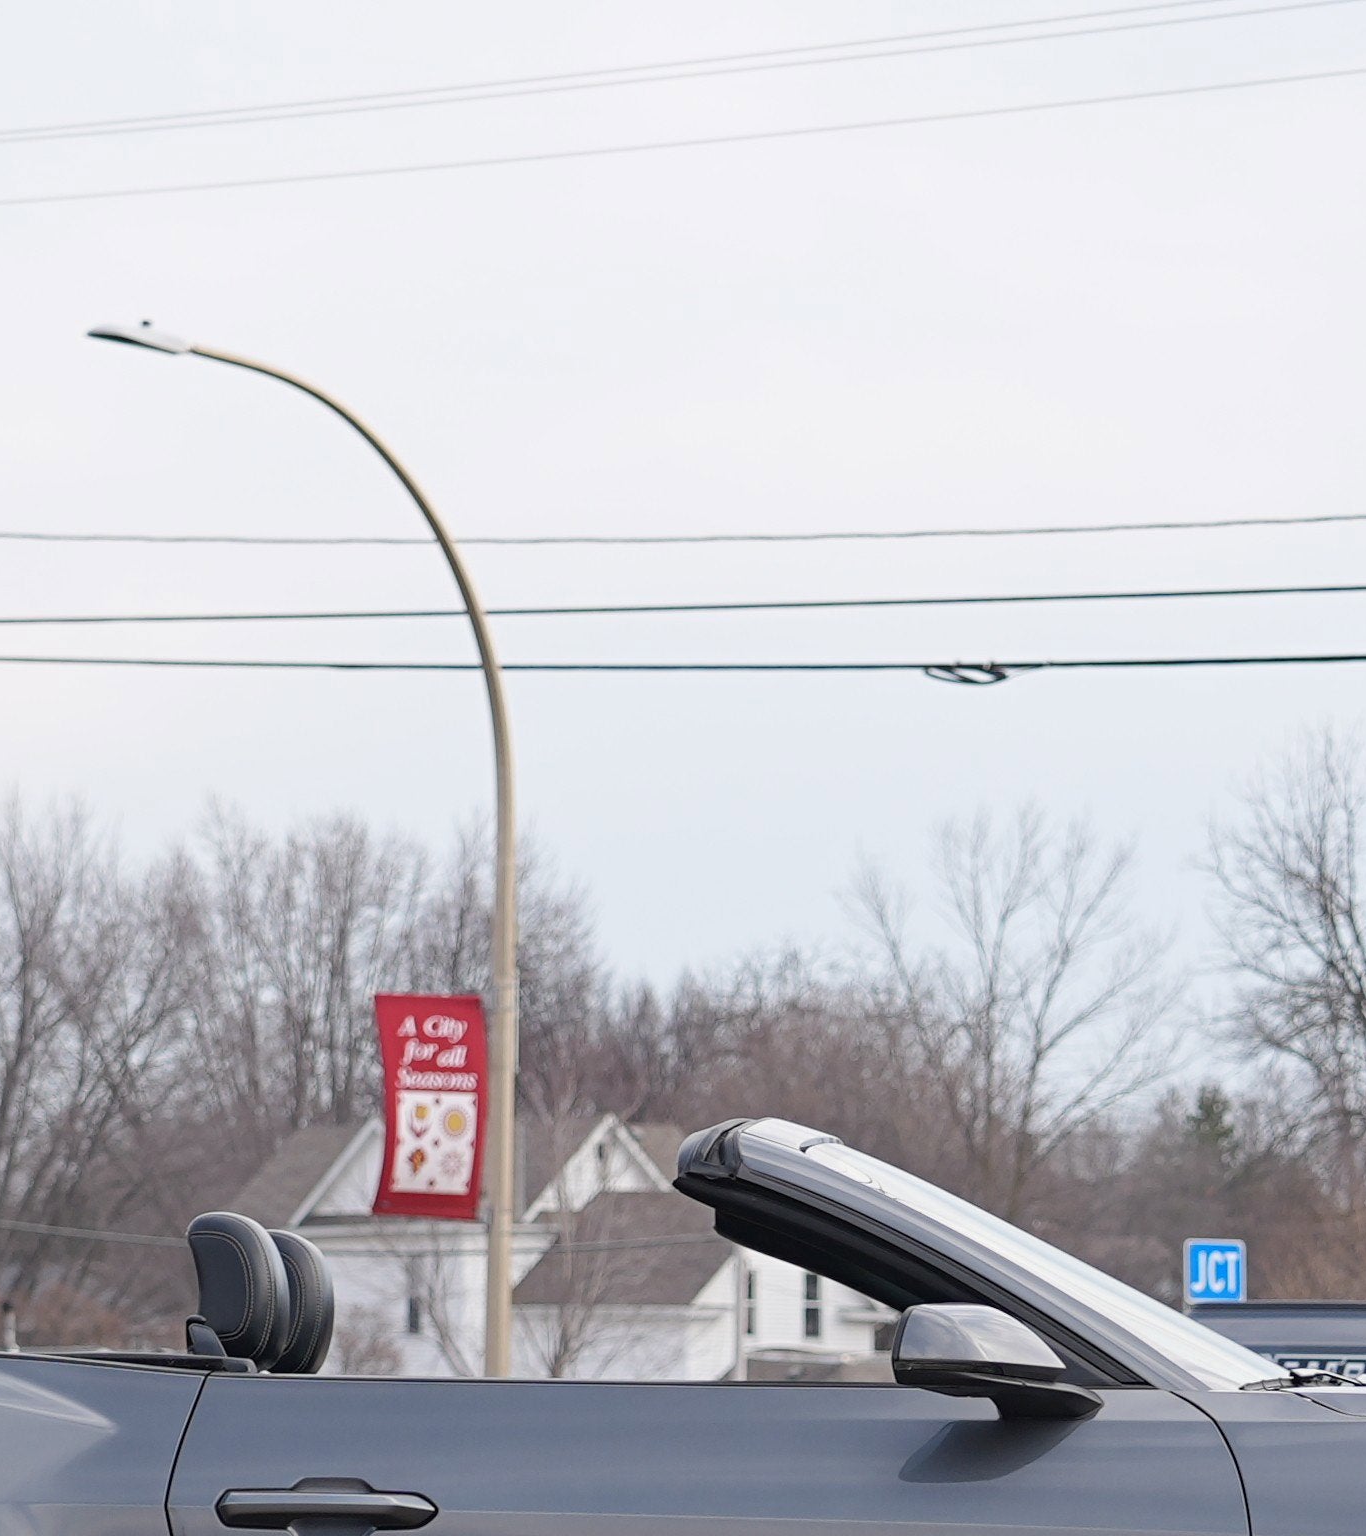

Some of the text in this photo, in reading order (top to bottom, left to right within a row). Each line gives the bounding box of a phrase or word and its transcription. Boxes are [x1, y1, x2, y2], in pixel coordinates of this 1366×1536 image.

[397, 1015, 468, 1044] A City
[399, 1038, 467, 1068] for all
[396, 1066, 479, 1091] Seasons
[1191, 1250, 1239, 1294] JCT
